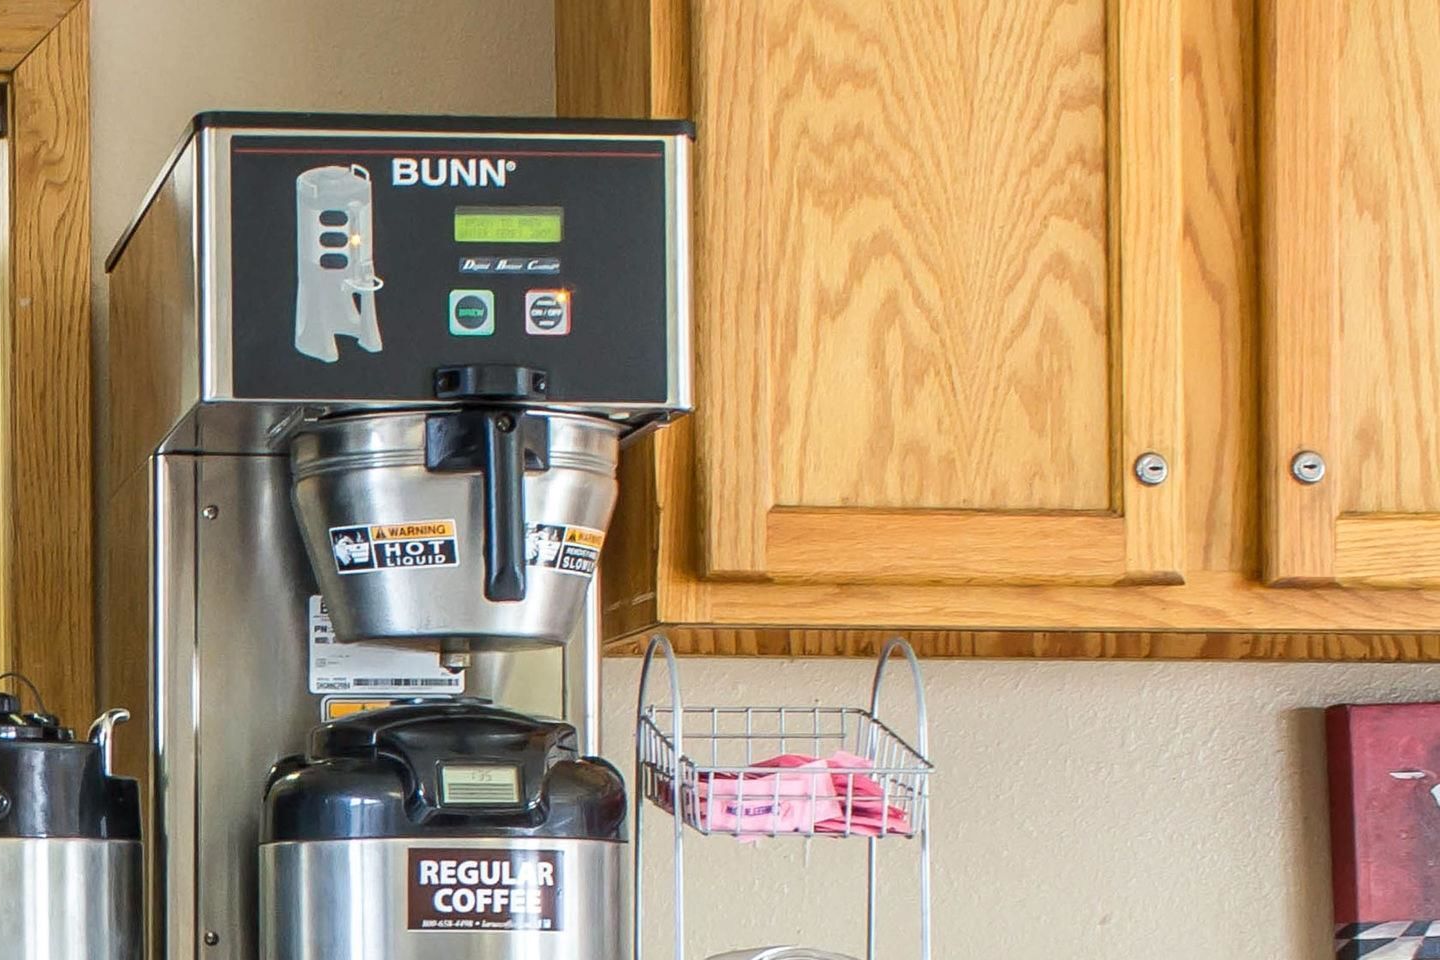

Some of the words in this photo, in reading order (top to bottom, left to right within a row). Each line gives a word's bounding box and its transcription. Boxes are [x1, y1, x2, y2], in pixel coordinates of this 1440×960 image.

[388, 524, 446, 537] WARNING
[384, 540, 445, 557] HOT
[386, 554, 446, 567] LIQUID
[419, 860, 554, 886] REGULAR
[433, 887, 542, 914] COFFEE
